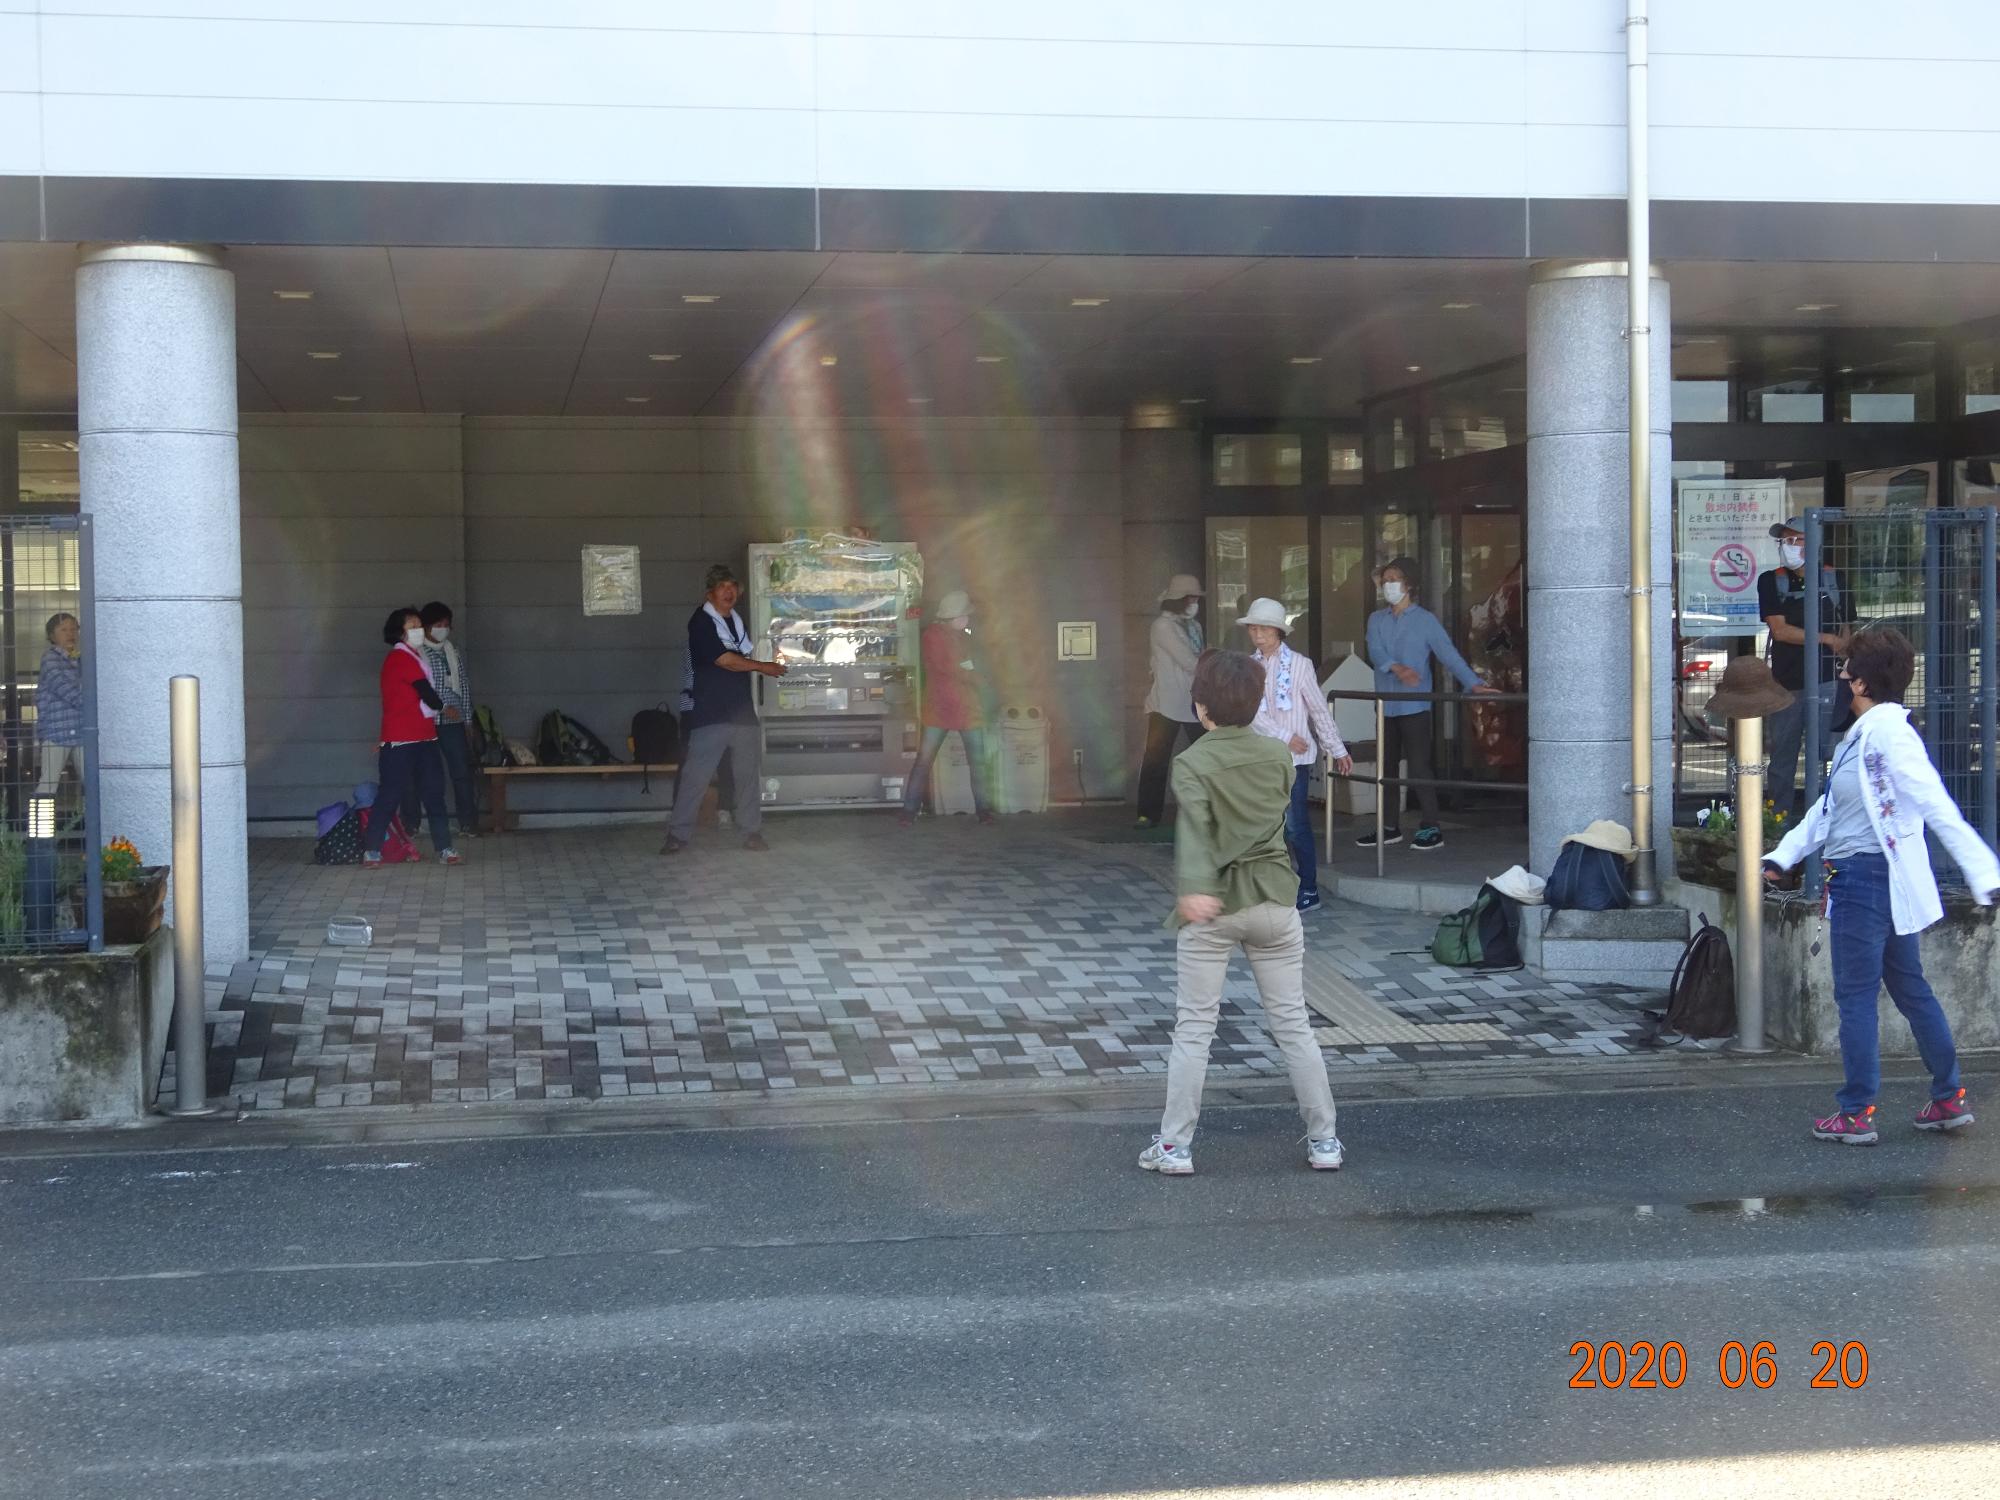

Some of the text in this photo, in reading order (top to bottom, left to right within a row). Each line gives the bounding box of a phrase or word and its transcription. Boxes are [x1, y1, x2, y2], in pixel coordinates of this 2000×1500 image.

[1705, 501, 1760, 513] 敷地内禁煙
[1688, 513, 1777, 523] とさせていただきます
